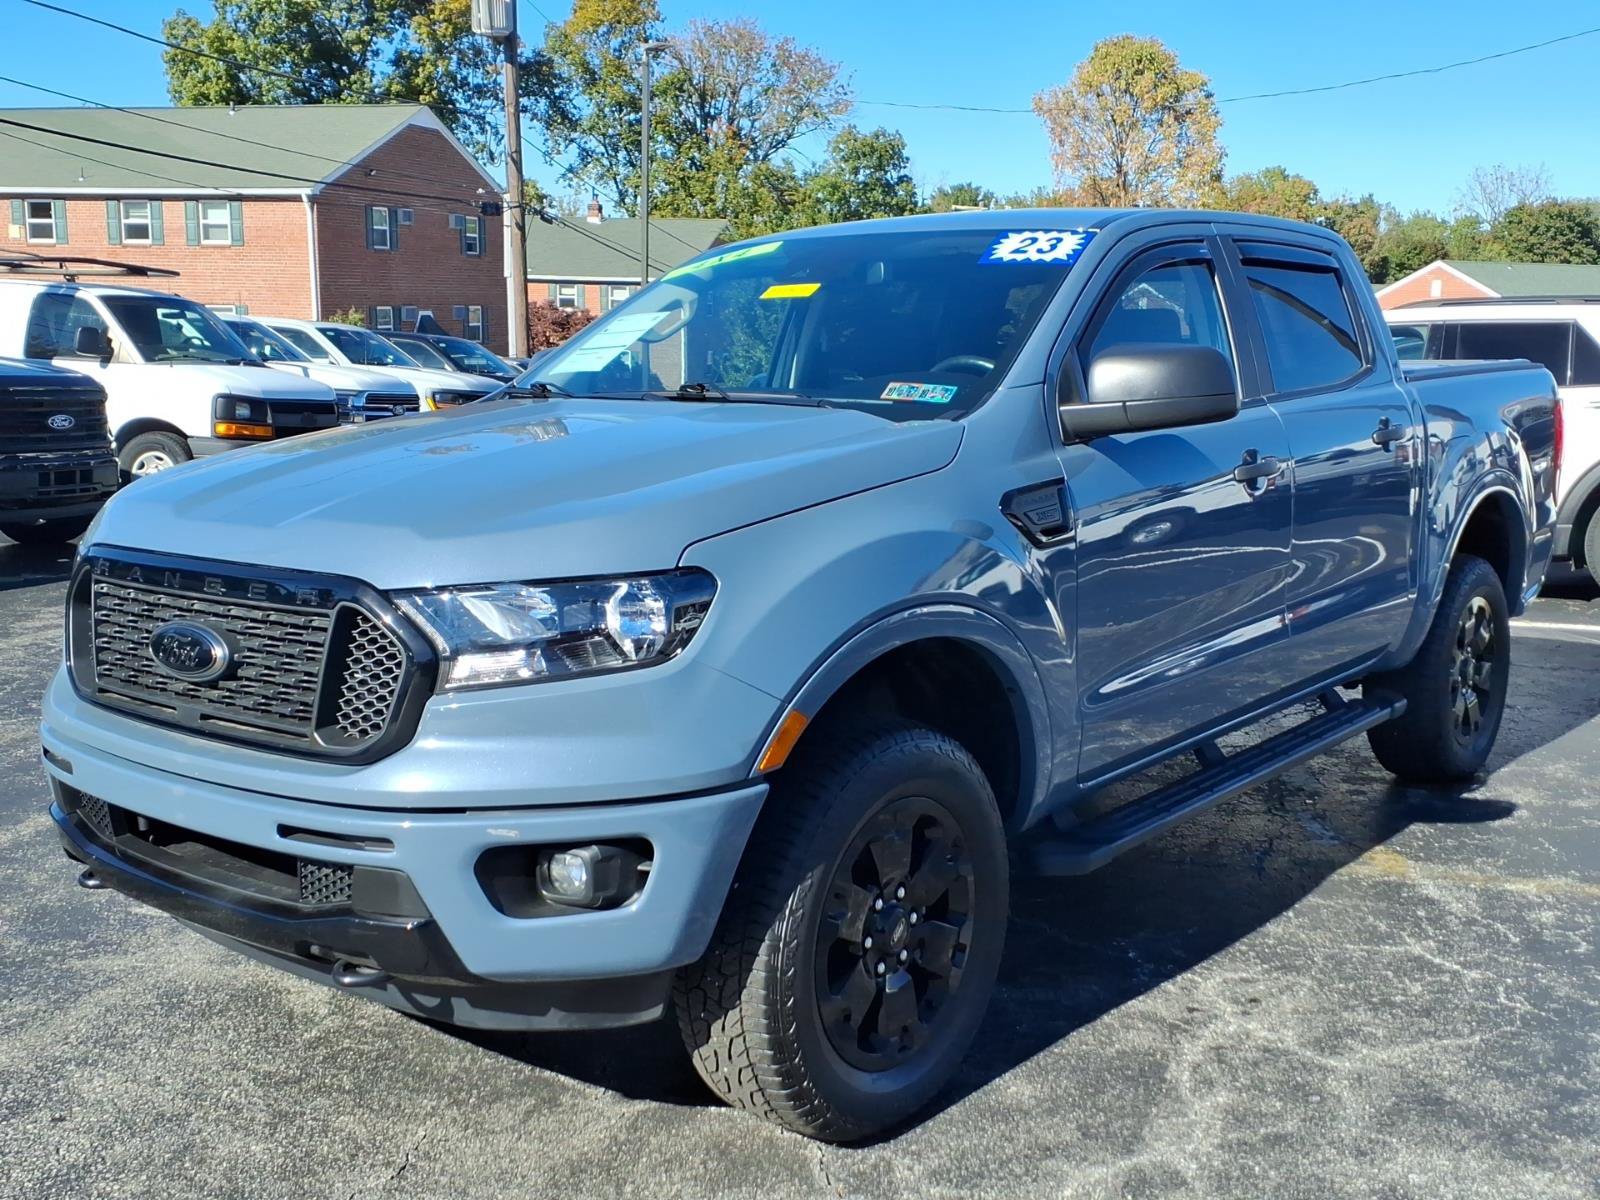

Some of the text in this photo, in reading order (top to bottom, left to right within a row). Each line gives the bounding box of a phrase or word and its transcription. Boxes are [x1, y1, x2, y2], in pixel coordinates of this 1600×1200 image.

[1008, 236, 1064, 255] 23
[94, 557, 320, 606] RANGER
[158, 633, 201, 668] Ford
